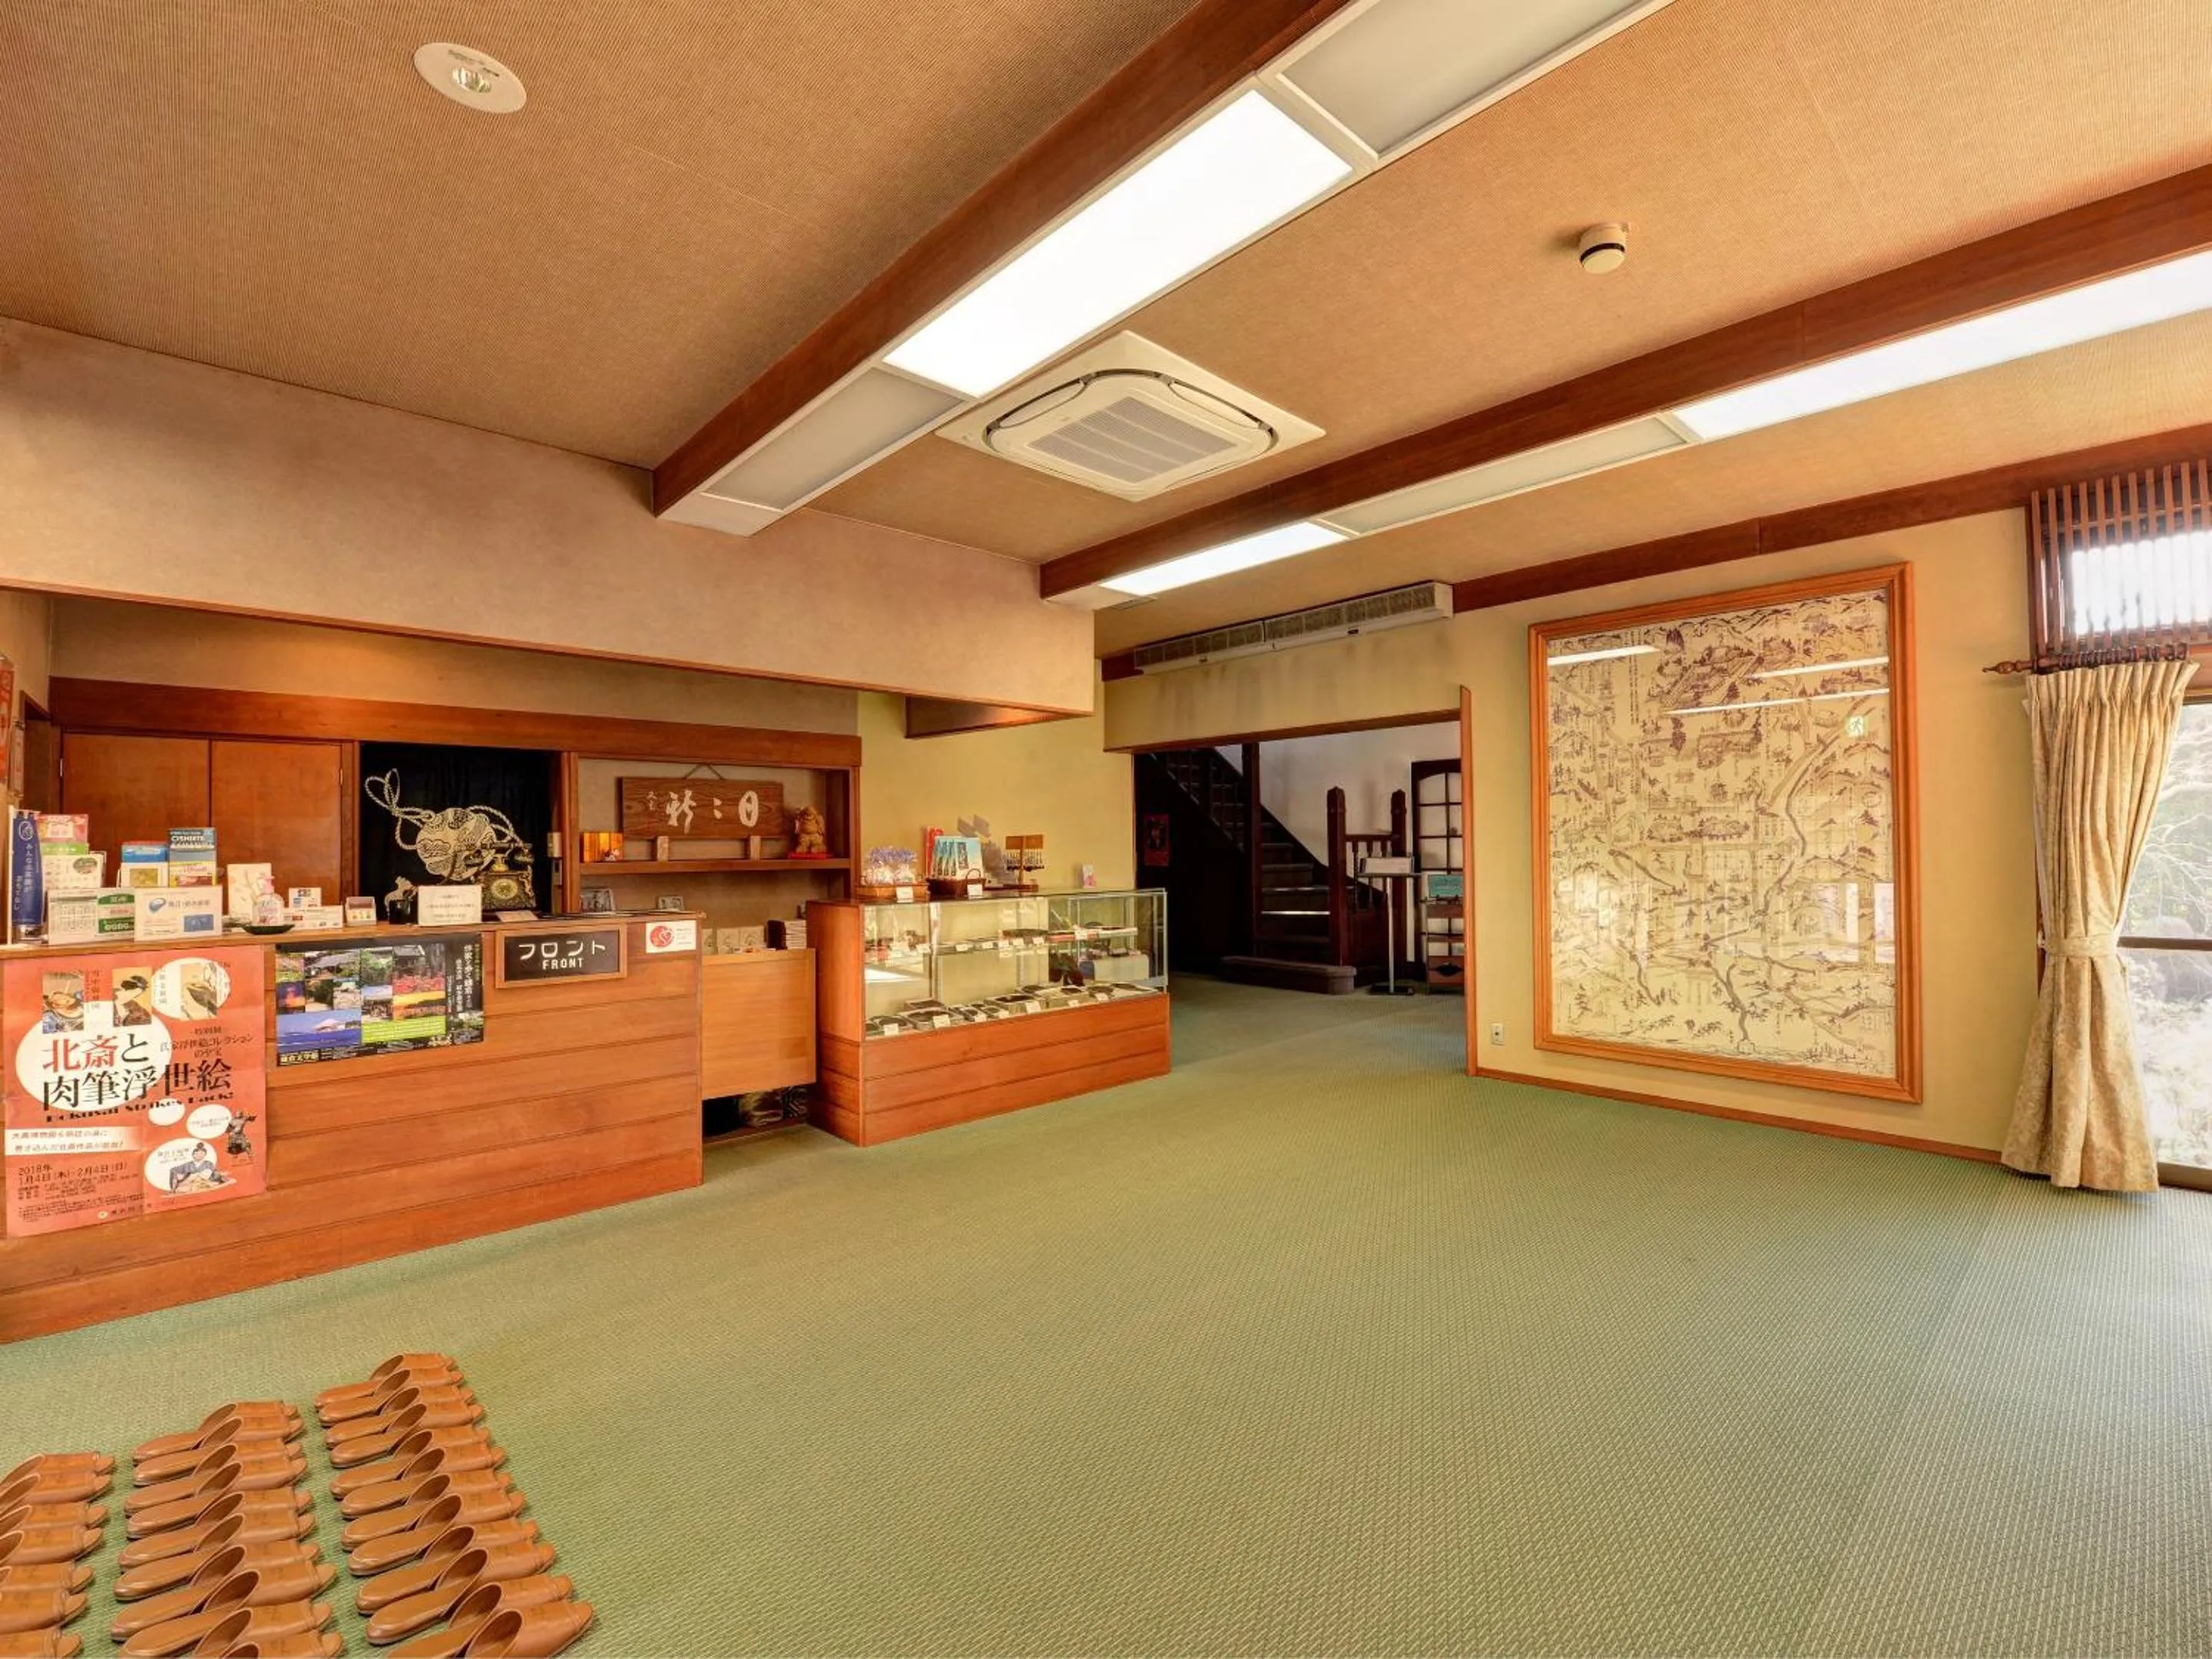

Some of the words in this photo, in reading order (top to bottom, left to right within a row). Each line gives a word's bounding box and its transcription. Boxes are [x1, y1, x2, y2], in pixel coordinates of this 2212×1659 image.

[518, 939, 605, 960] フロント
[542, 958, 584, 969] FRONT
[42, 1033, 149, 1073] 北斎と
[43, 1058, 233, 1111] 肉筆浮世絵
